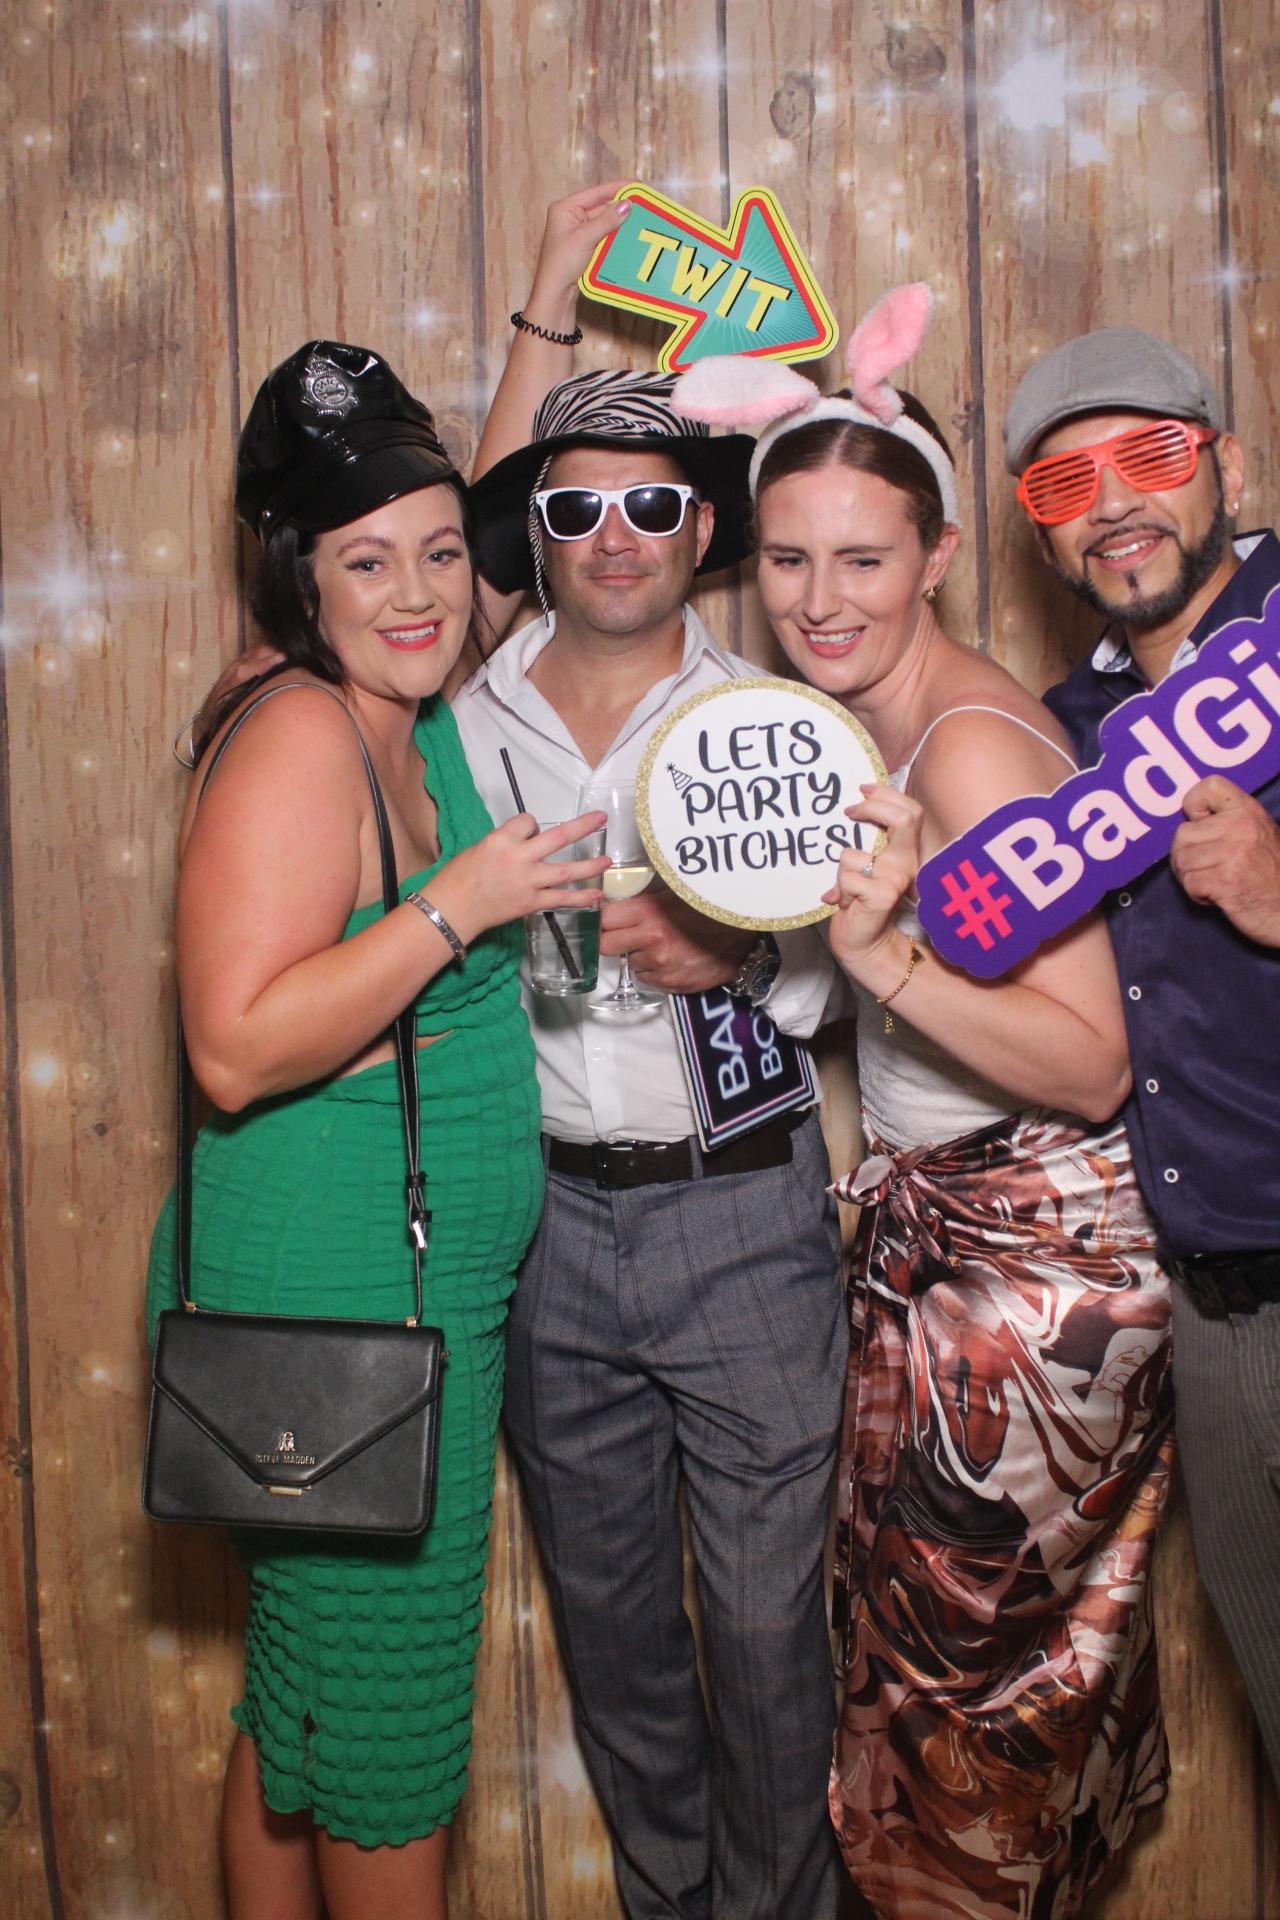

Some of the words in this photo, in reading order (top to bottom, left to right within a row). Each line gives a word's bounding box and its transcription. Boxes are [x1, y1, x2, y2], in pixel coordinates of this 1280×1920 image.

[636, 228, 792, 332] TWIT
[698, 720, 822, 774] LETS
[681, 771, 842, 826] PARTY
[941, 638, 1280, 952] #BadGi
[750, 1011, 783, 1080] BO
[283, 1455, 315, 1464] MADDEN
